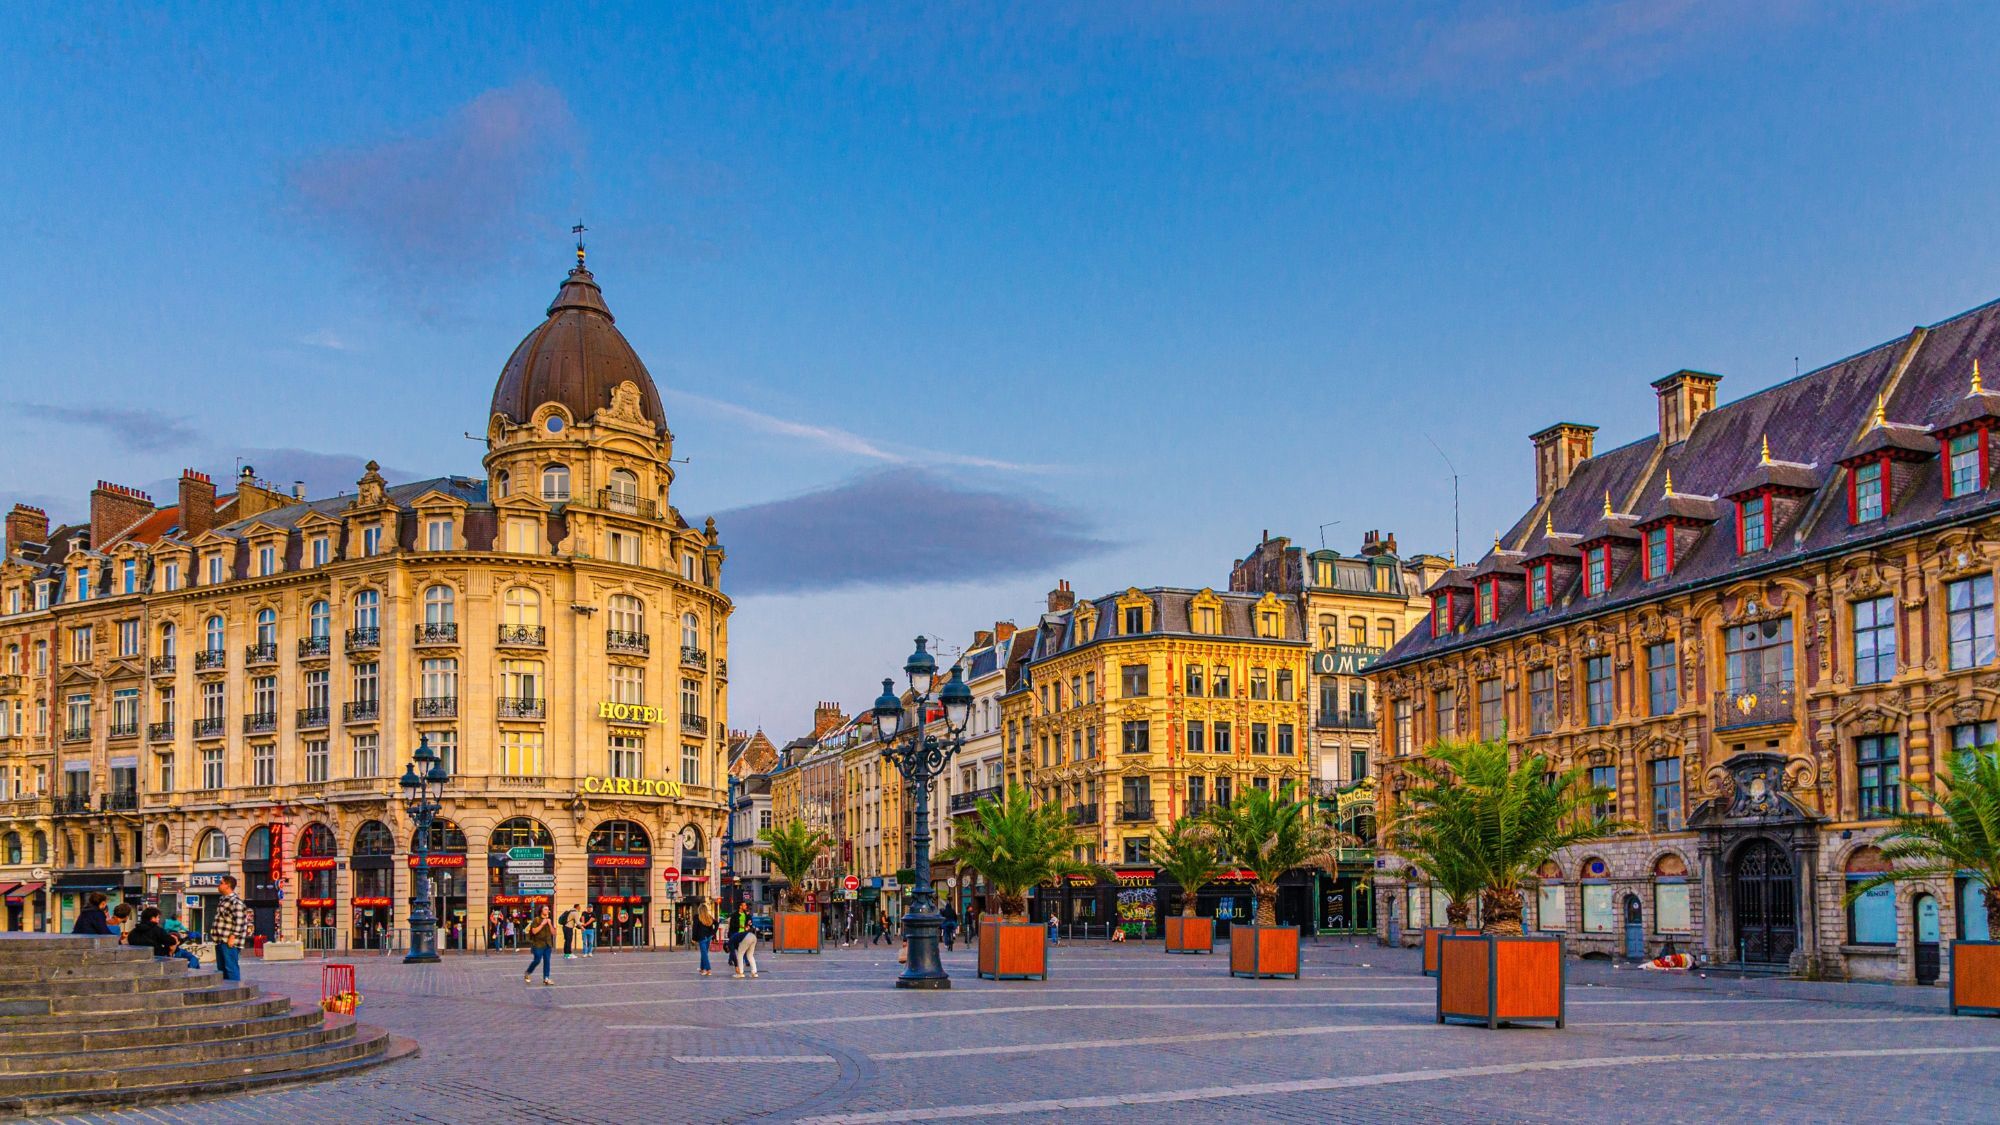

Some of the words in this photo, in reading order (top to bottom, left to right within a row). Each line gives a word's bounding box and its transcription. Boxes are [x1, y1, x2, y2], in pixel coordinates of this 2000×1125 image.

[1340, 646, 1381, 656] MONTRE
[1322, 653, 1379, 673] OME
[597, 702, 668, 724] HOTEL
[584, 776, 682, 797] CARLTON
[271, 824, 281, 881] HIPPO
[409, 857, 463, 866] HIPOTAMUS
[1122, 879, 1152, 887] PAUL
[495, 895, 520, 904] Service
[1215, 907, 1246, 919] PAUL
